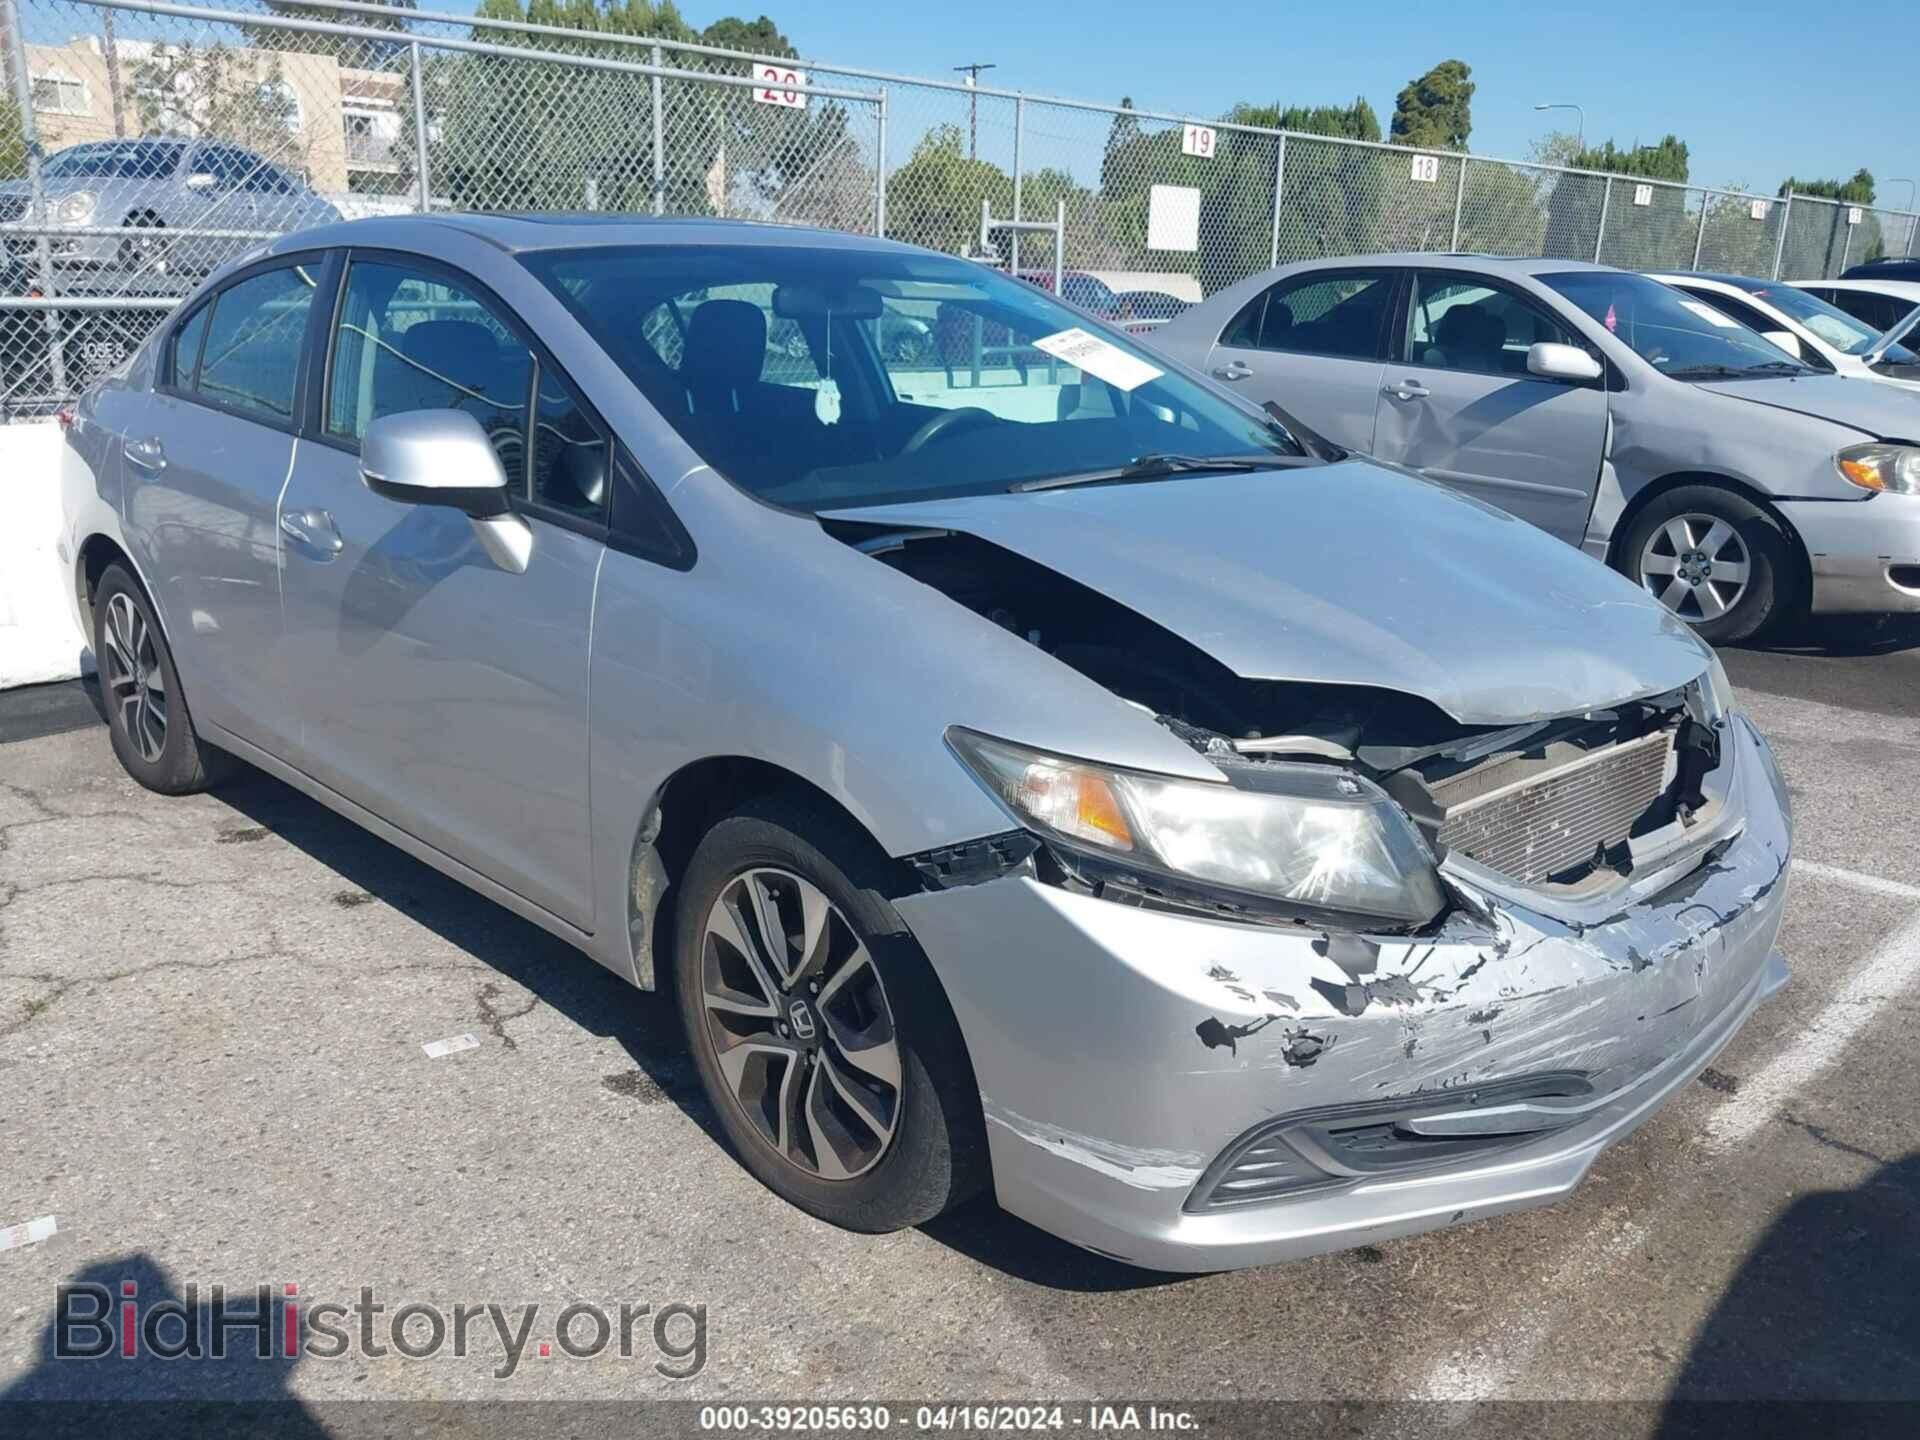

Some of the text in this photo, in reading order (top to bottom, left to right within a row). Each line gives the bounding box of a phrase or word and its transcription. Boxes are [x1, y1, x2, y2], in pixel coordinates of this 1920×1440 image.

[763, 69, 797, 104] 20
[1190, 128, 1210, 154] 19
[1417, 159, 1433, 179] 18
